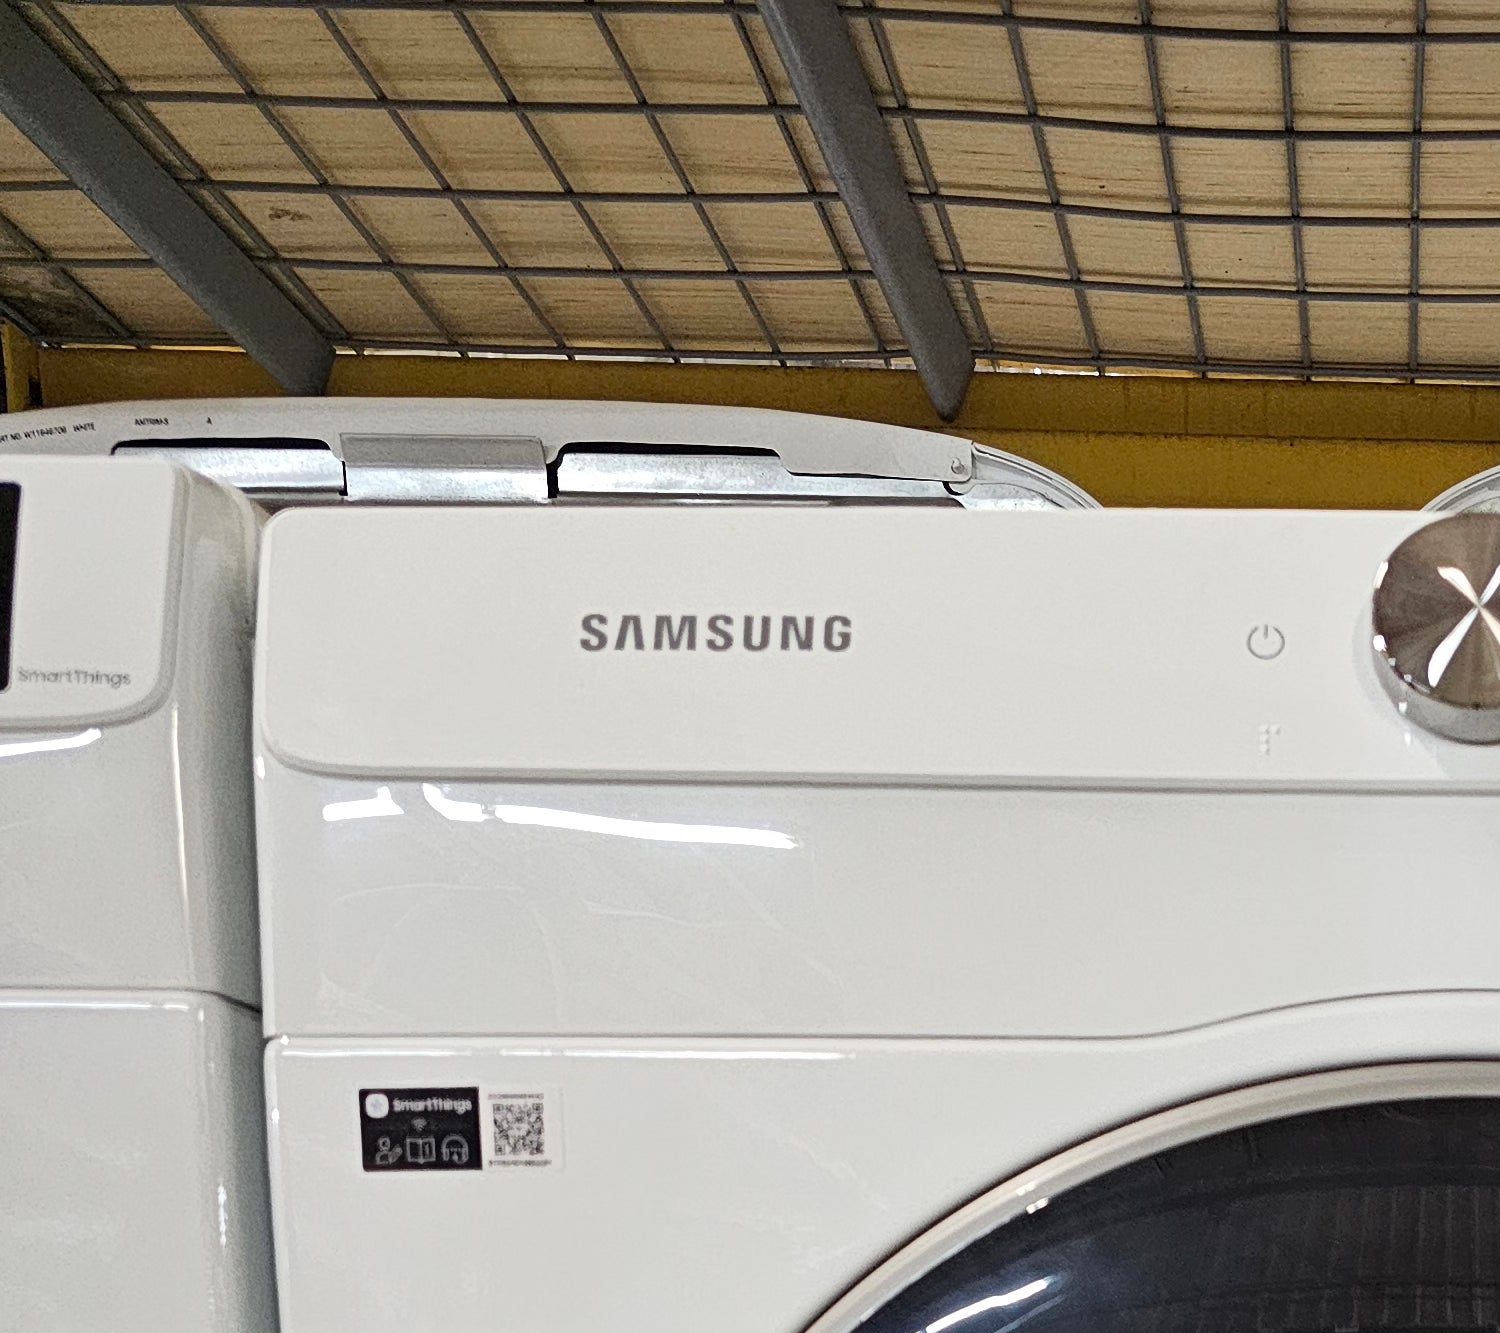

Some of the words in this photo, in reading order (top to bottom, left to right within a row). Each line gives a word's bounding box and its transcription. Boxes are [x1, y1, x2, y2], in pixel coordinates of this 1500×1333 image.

[579, 613, 852, 652] SAMSUNG
[18, 667, 132, 689] SmartThings
[392, 1097, 472, 1115] SmartThings
